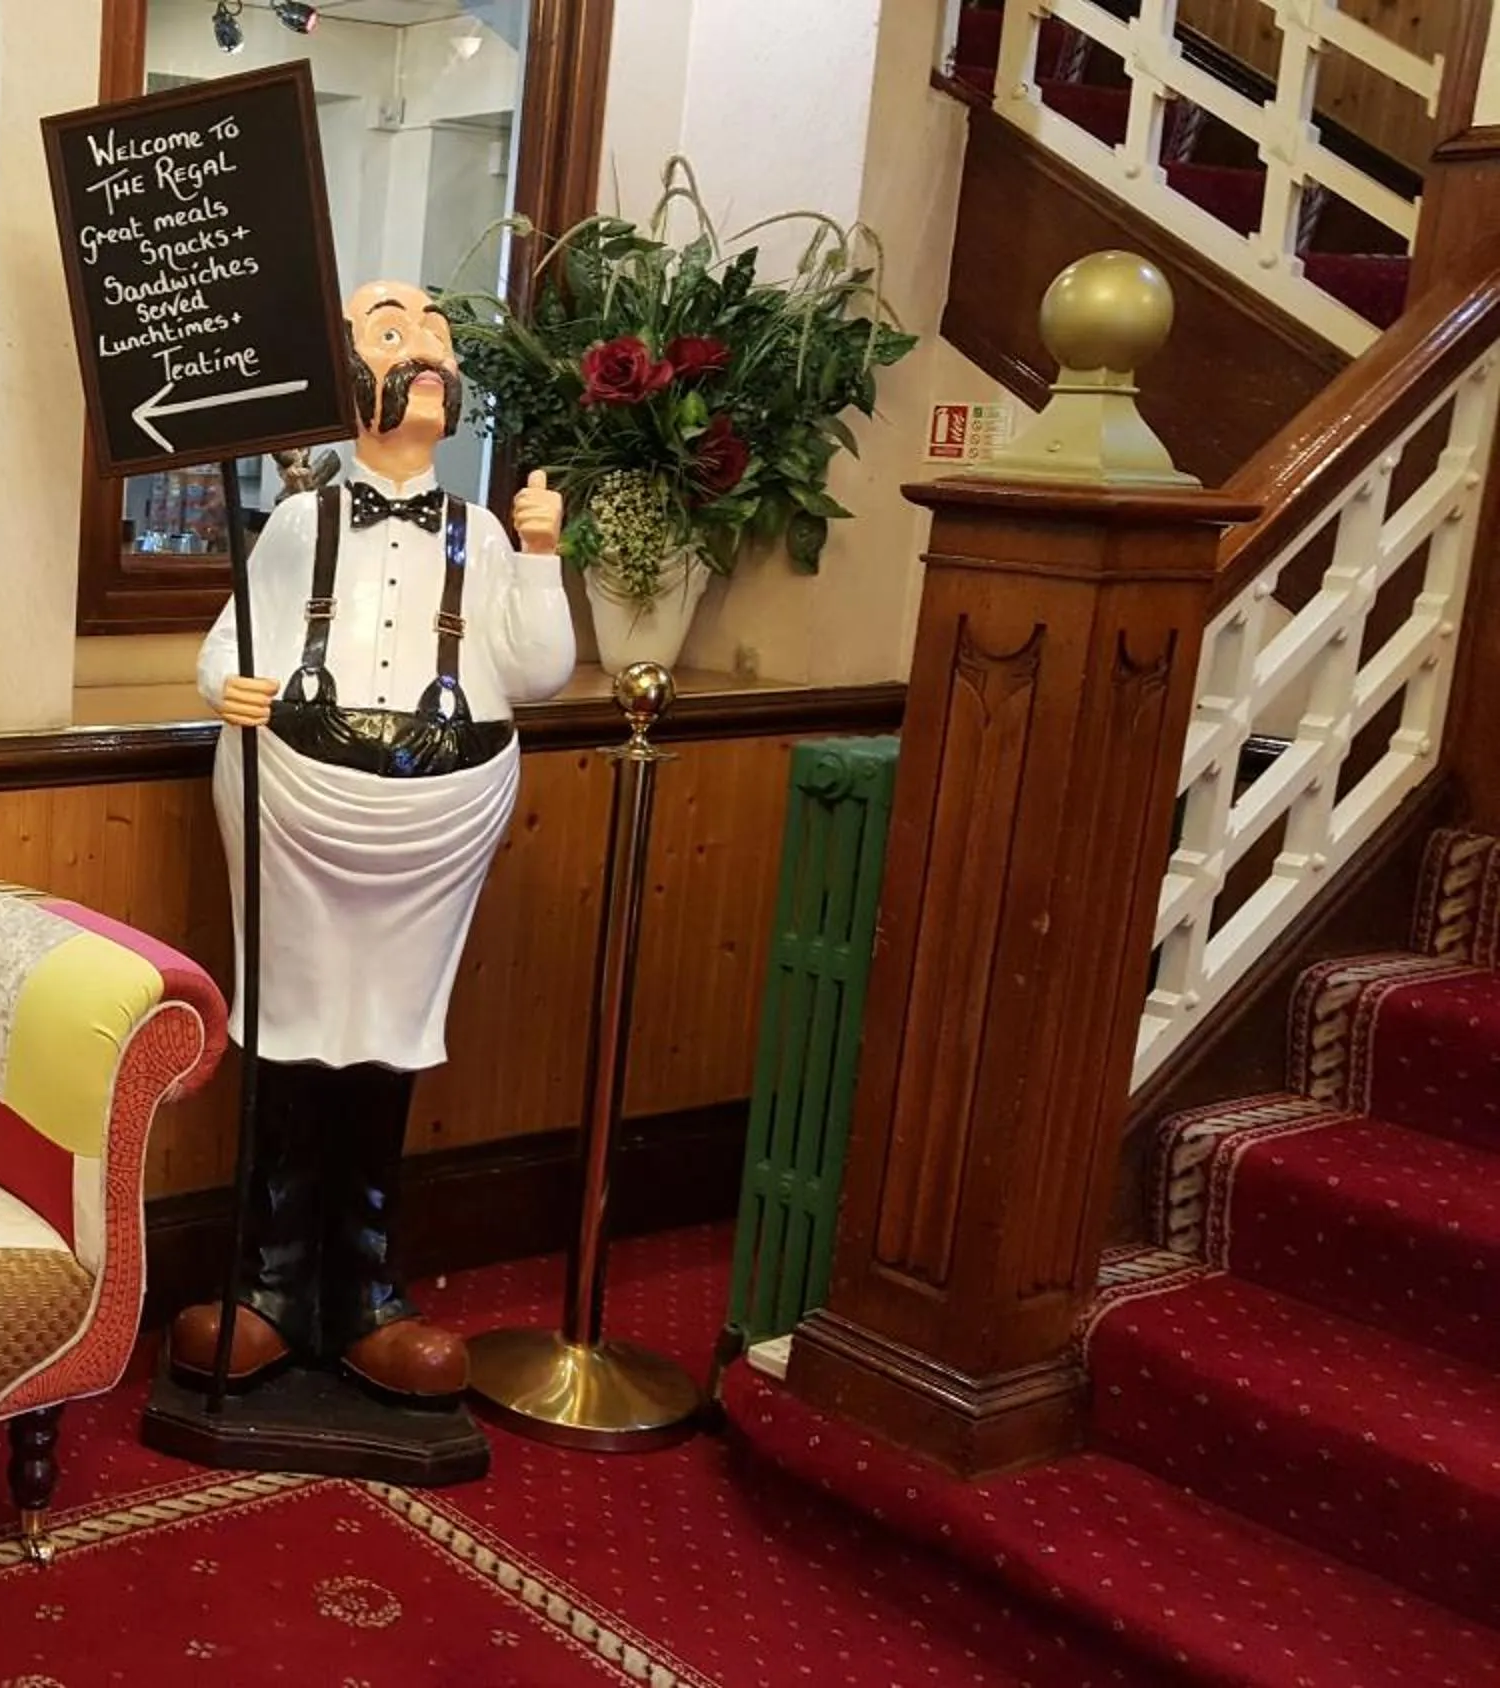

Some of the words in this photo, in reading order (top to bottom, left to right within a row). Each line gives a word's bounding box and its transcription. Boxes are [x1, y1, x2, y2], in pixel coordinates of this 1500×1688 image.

[207, 115, 240, 140] TO
[86, 168, 146, 216] THE
[155, 151, 237, 201] REGAL
[80, 216, 145, 265] Great
[154, 196, 229, 232] meals
[103, 256, 260, 305] Sandwiches
[152, 345, 261, 381] Teatime
